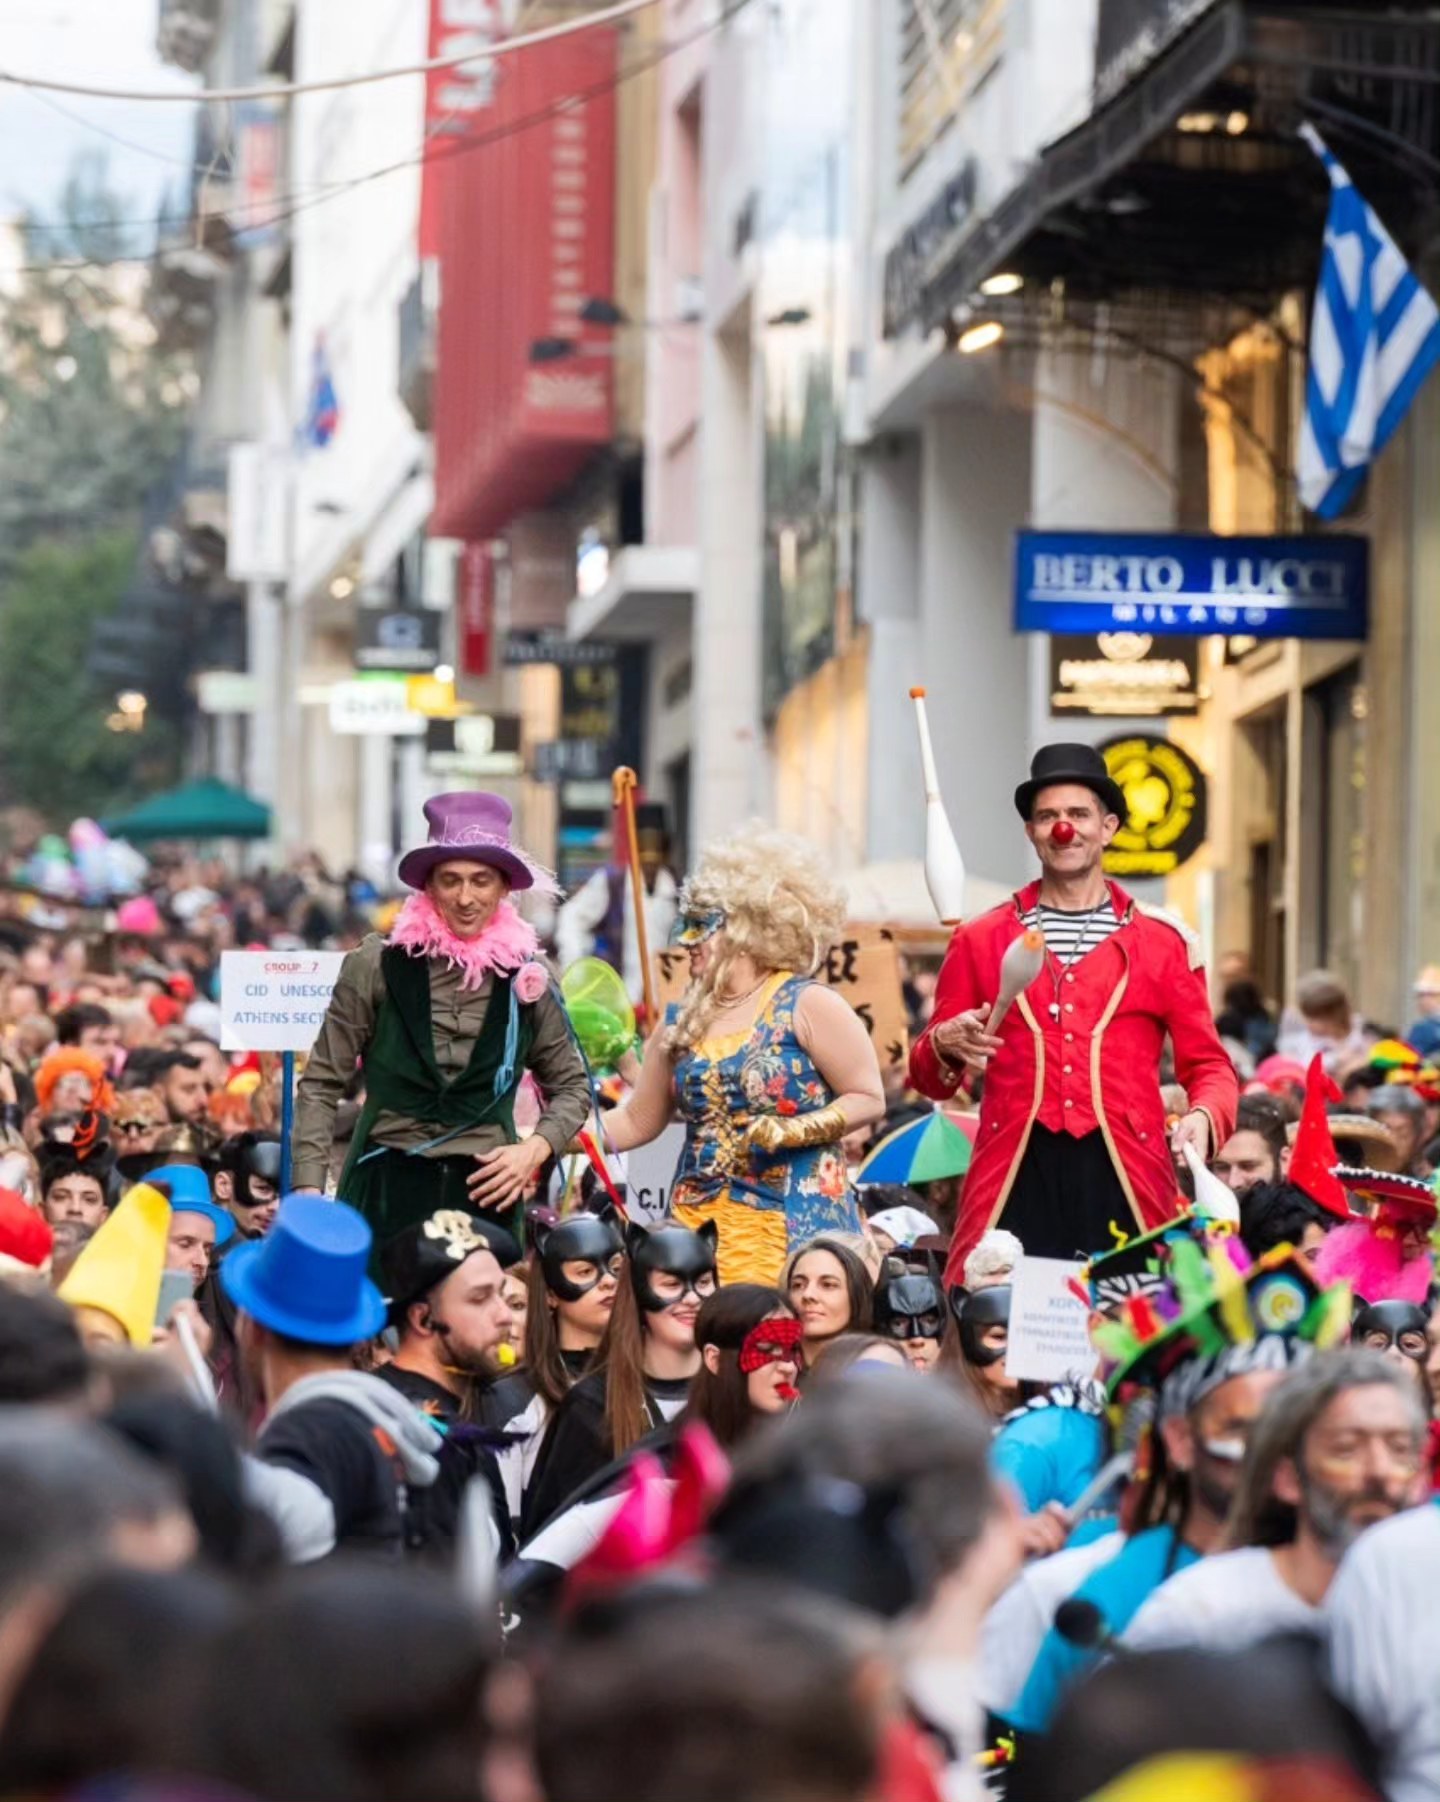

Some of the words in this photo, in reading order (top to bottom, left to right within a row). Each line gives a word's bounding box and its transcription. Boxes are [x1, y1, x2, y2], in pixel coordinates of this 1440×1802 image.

[1033, 554, 1184, 593] BERTO
[1211, 557, 1346, 597] LUCCI
[1112, 603, 1267, 625] MILANO
[245, 983, 268, 997] CID
[233, 1012, 289, 1024] ATHENS
